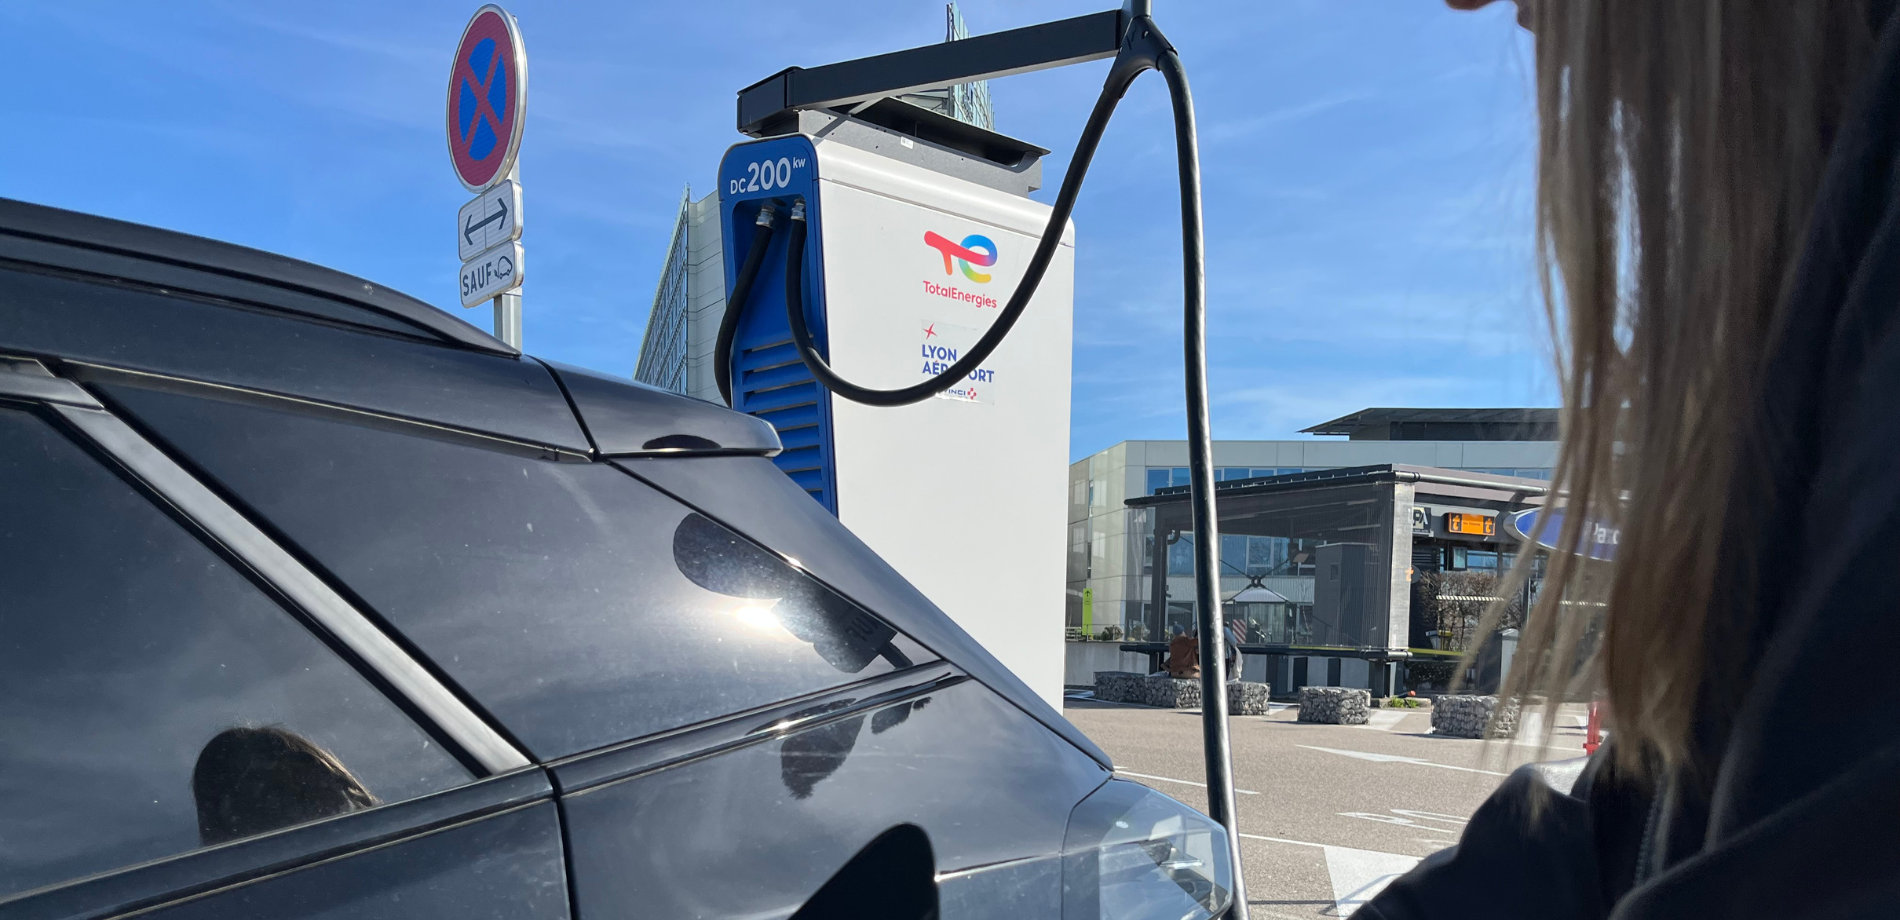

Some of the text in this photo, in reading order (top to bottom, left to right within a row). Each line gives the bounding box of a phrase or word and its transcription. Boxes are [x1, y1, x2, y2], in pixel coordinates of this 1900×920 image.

[730, 178, 746, 194] DC
[747, 157, 791, 192] 200
[462, 261, 492, 297] SAUF
[923, 280, 997, 308] TotalEnergies
[922, 344, 957, 362] LYON
[922, 360, 995, 383] AÉORT
[944, 388, 966, 396] INCI
[1584, 521, 1620, 545] Pac
